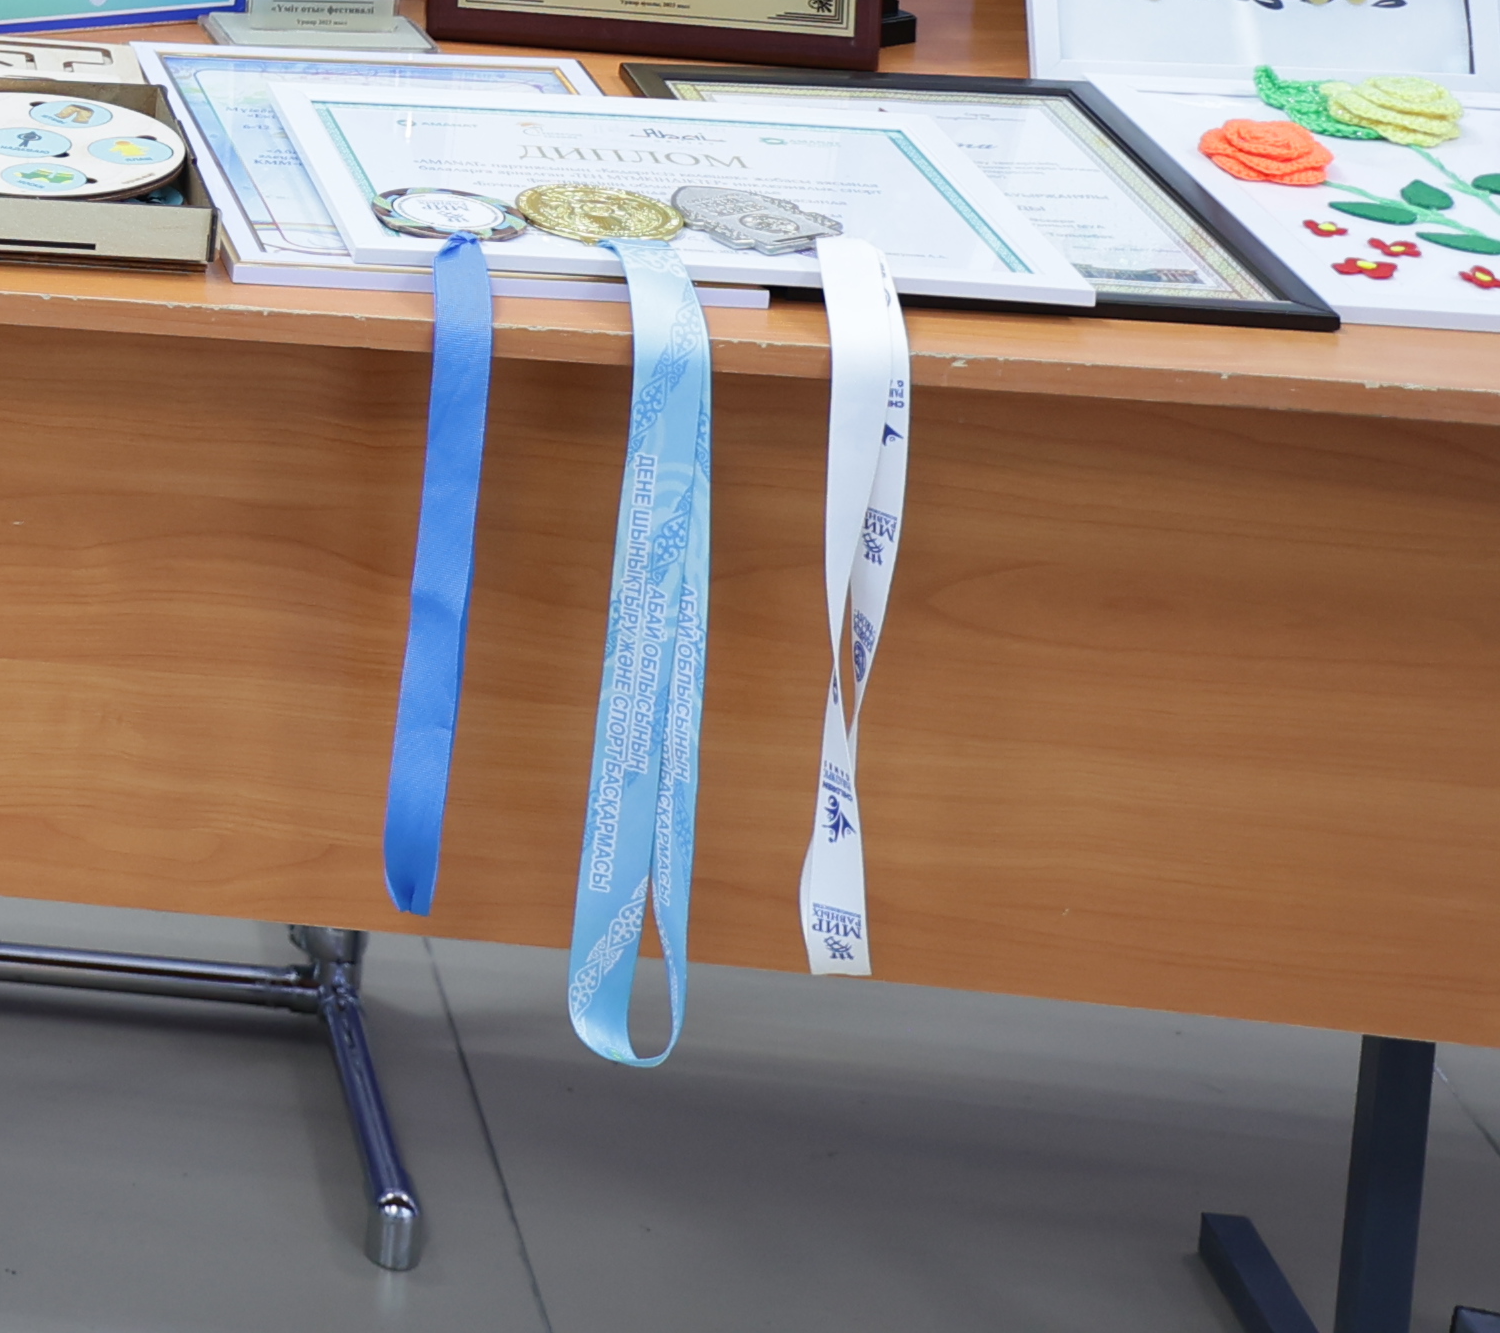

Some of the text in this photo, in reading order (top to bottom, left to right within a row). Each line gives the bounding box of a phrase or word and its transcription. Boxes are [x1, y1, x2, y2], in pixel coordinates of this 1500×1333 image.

[326, 5, 375, 16] фестивалі
[517, 144, 751, 170] ДИПЛОМ
[634, 453, 656, 505] ДЕНЕ
[621, 509, 650, 637] ШЫНЫҚТЫРУ
[642, 584, 668, 642] АБАЙ
[677, 584, 700, 642] АБАЙ
[612, 637, 638, 693] ЖӘНЕ
[605, 694, 629, 760] СПОРТ
[811, 905, 862, 927] РАВНЫХ
[811, 919, 863, 941] МИР
